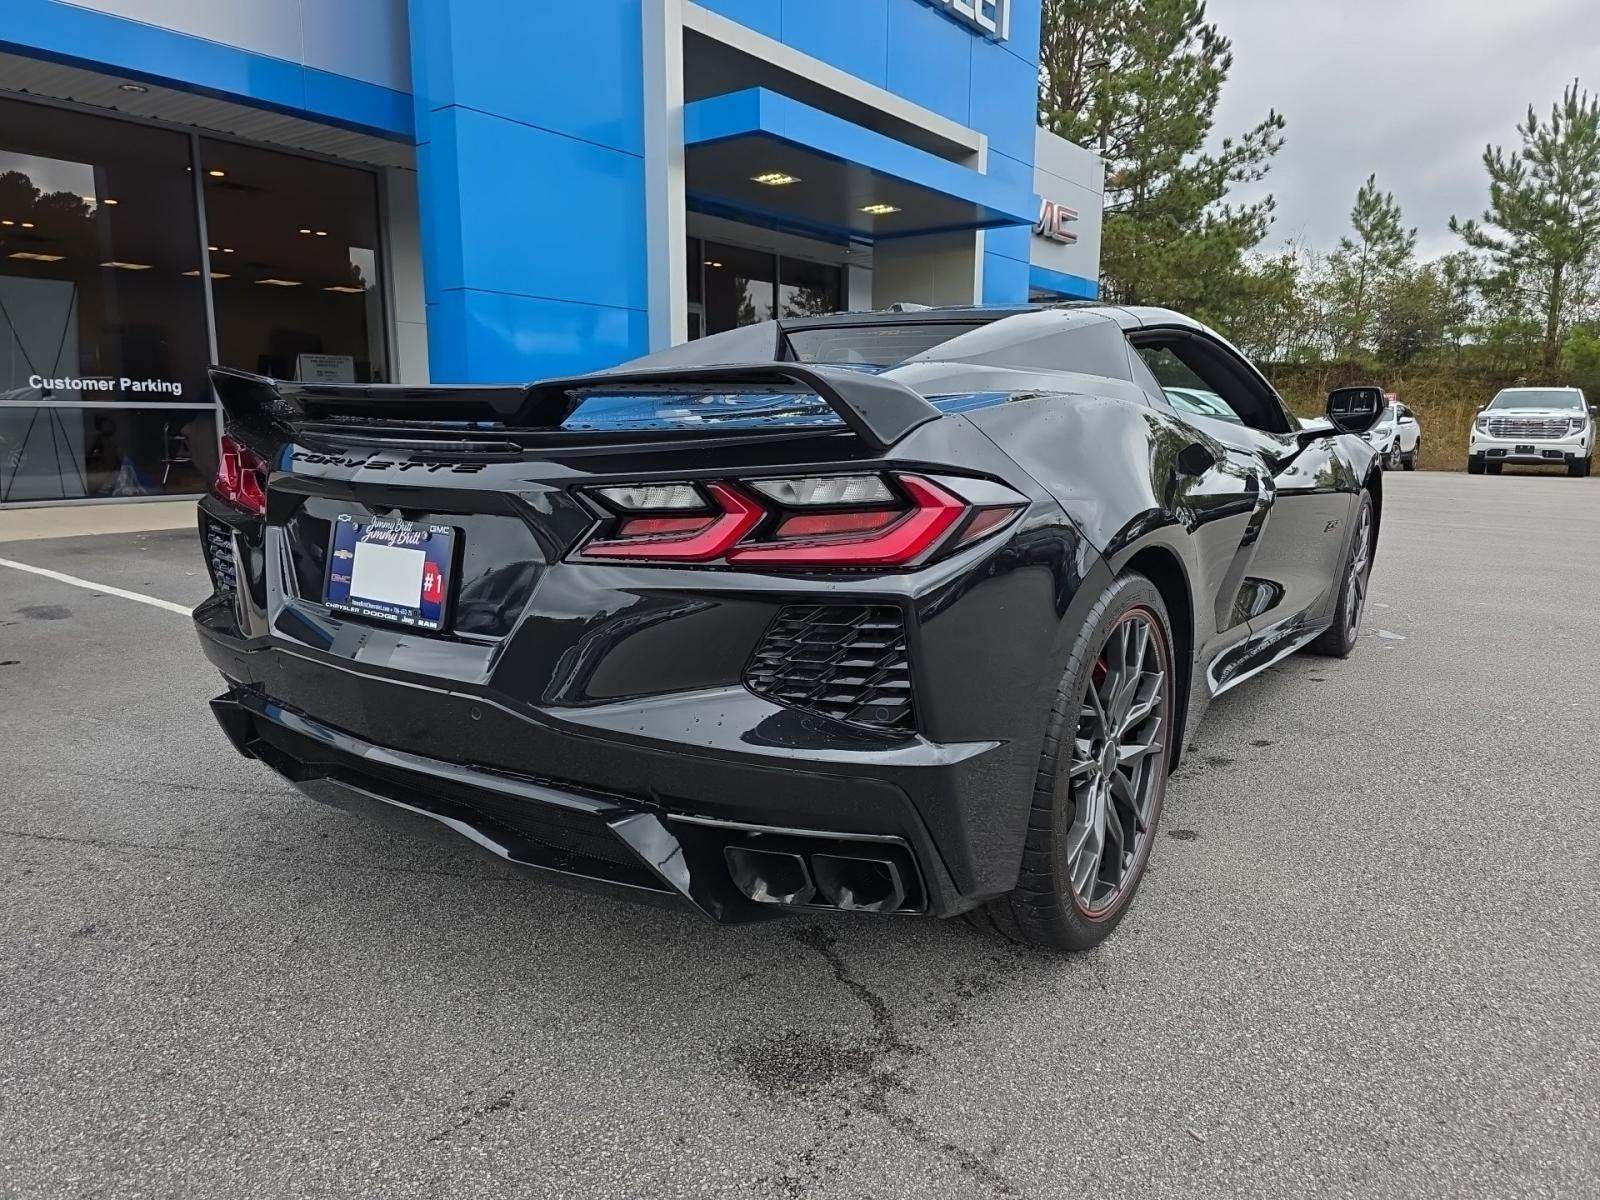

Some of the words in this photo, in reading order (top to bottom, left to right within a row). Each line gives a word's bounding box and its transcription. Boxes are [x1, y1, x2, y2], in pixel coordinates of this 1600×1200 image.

[29, 374, 115, 391] Customer
[120, 377, 182, 396] Parking
[290, 452, 487, 473] CORVETTE
[370, 515, 396, 532] Jimmy
[395, 518, 414, 533] Britt
[429, 525, 450, 534] GMC
[361, 525, 398, 547] Jimmy
[397, 531, 421, 545] Britt
[423, 572, 442, 594] #1
[325, 601, 360, 613] CHRYSLER
[363, 609, 398, 621] DODGE
[401, 615, 415, 626] Jeep
[418, 619, 438, 629] RAM
